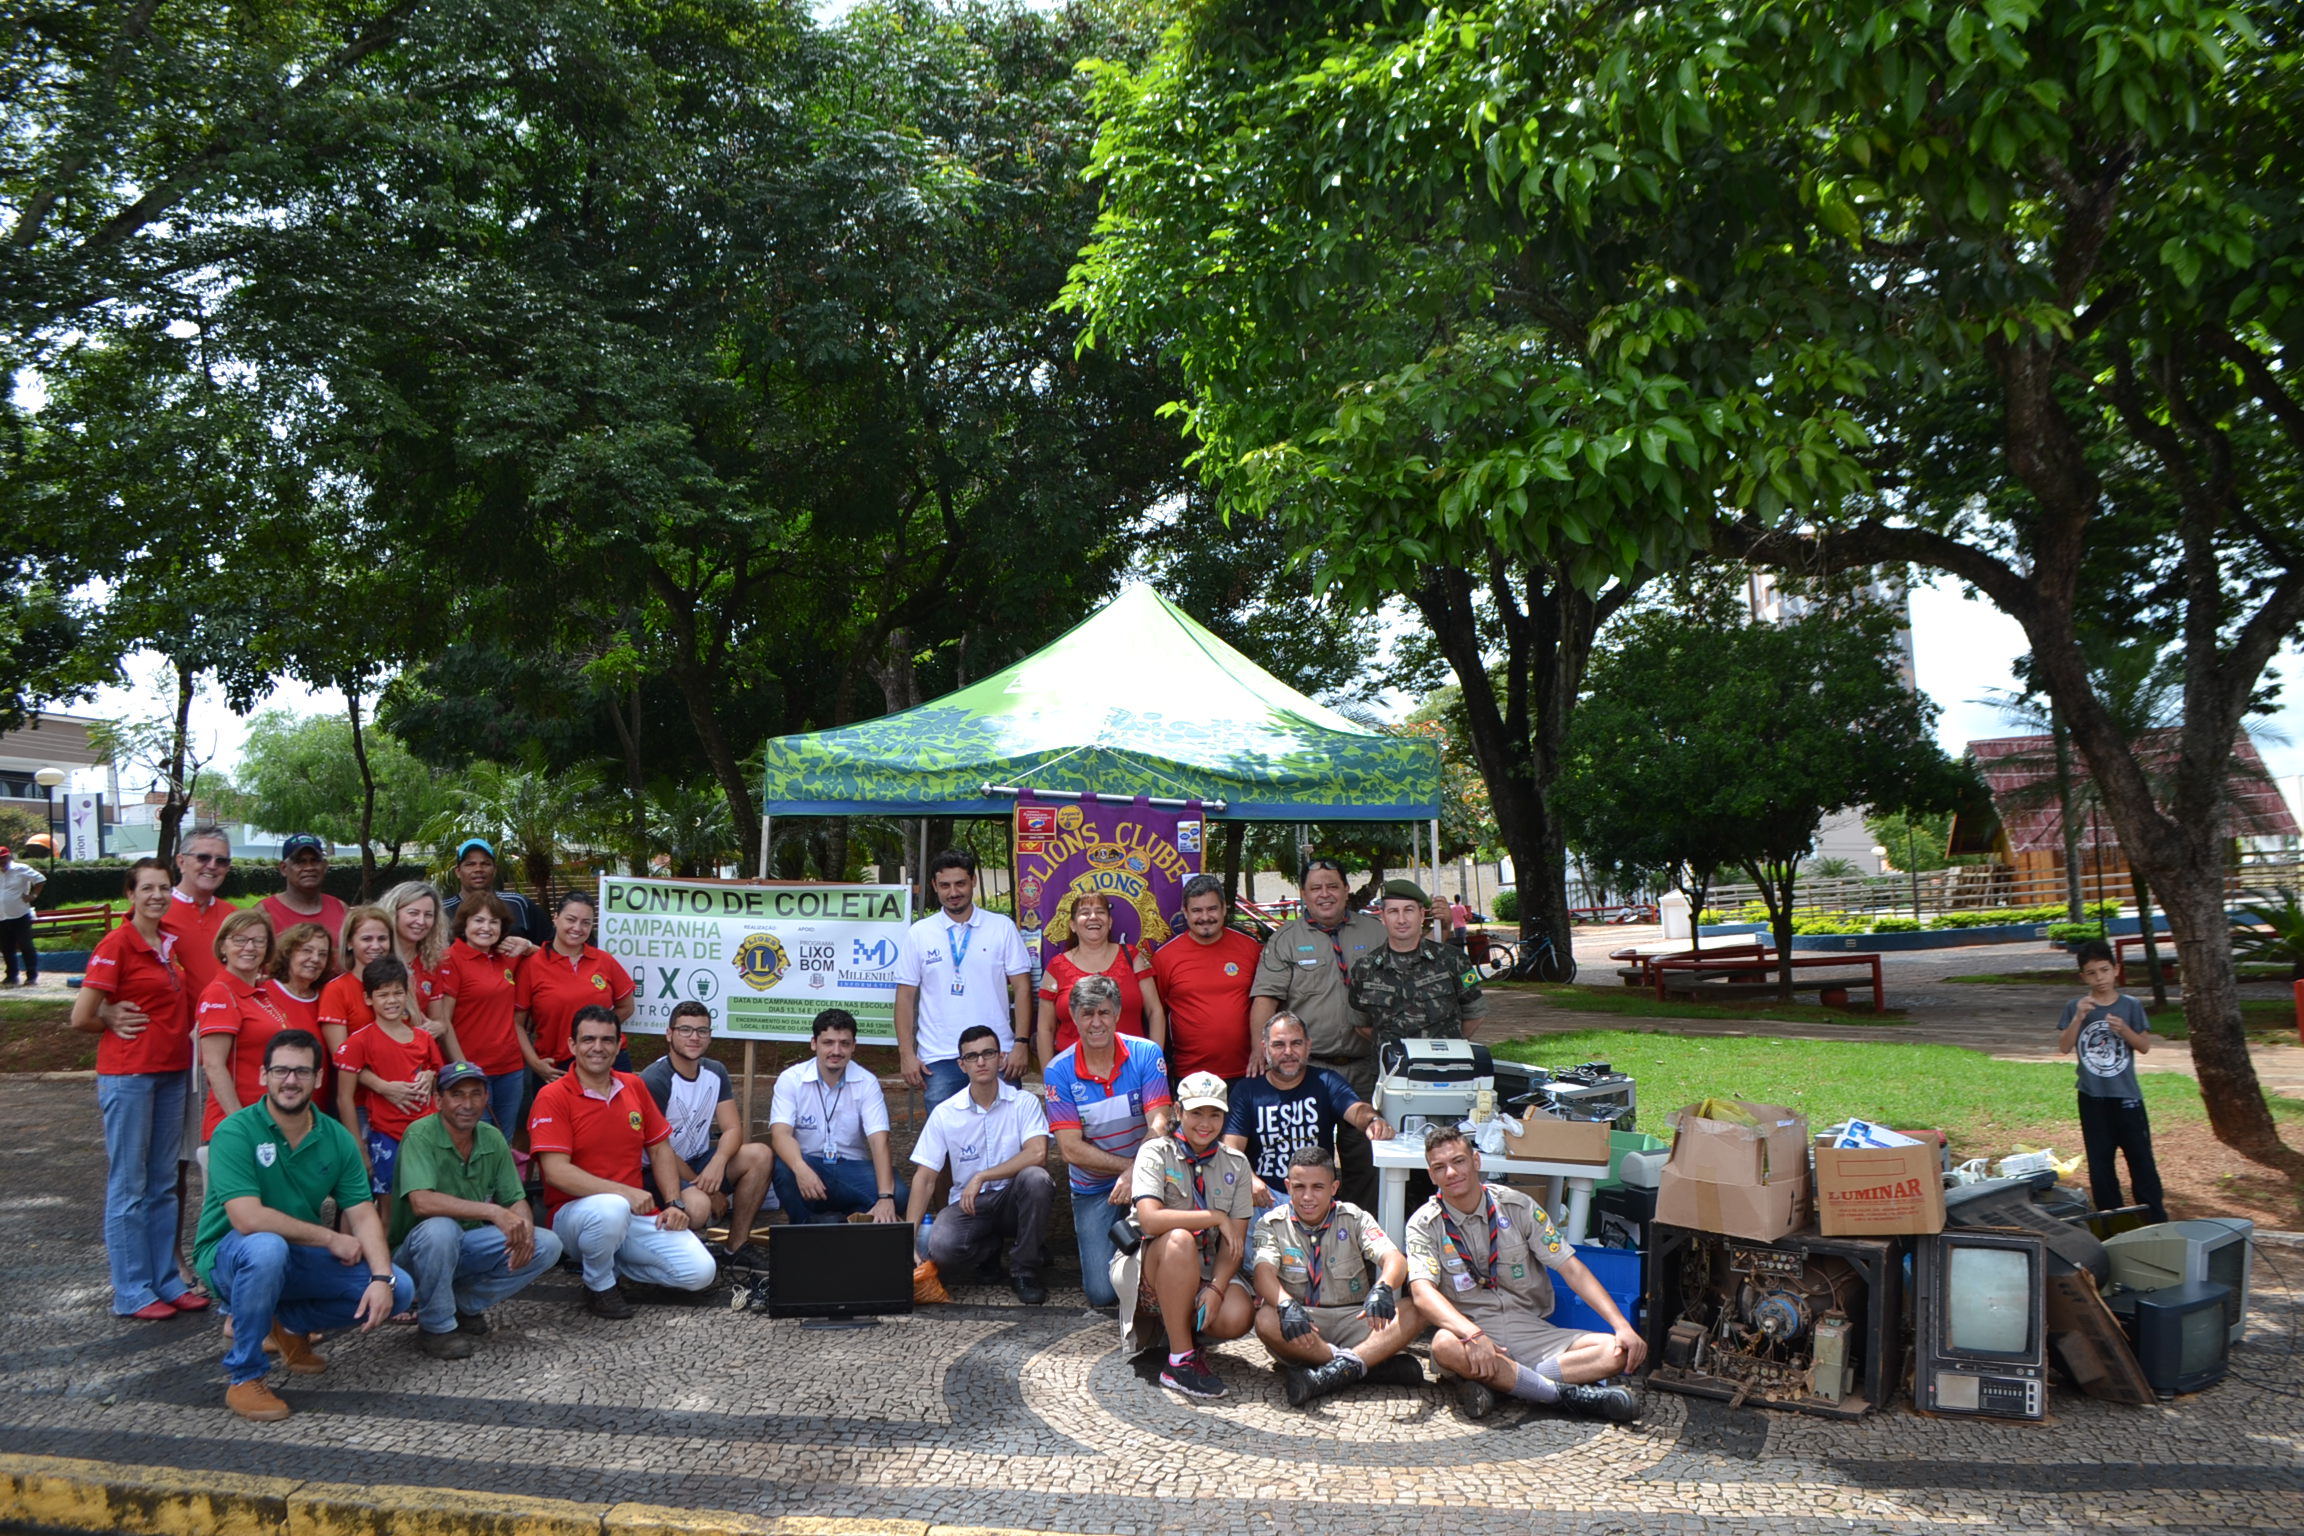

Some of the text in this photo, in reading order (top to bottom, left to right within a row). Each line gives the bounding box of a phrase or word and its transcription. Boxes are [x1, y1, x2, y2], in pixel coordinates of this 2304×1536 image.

[1027, 822, 1191, 883] LIONS CLUBE
[1076, 872, 1144, 897] LIONS
[608, 885, 901, 918] PONTO DE COLETA
[605, 917, 721, 939] CAMPANHA
[605, 938, 721, 960] COLETA DE
[800, 946, 835, 958] LIXO
[800, 959, 834, 972] BOM
[764, 998, 802, 1006] CAMPANHA
[1256, 1096, 1319, 1134] JESUS
[1260, 1124, 1320, 1154] JESUS
[1827, 1178, 1923, 1201] LUMINAR
